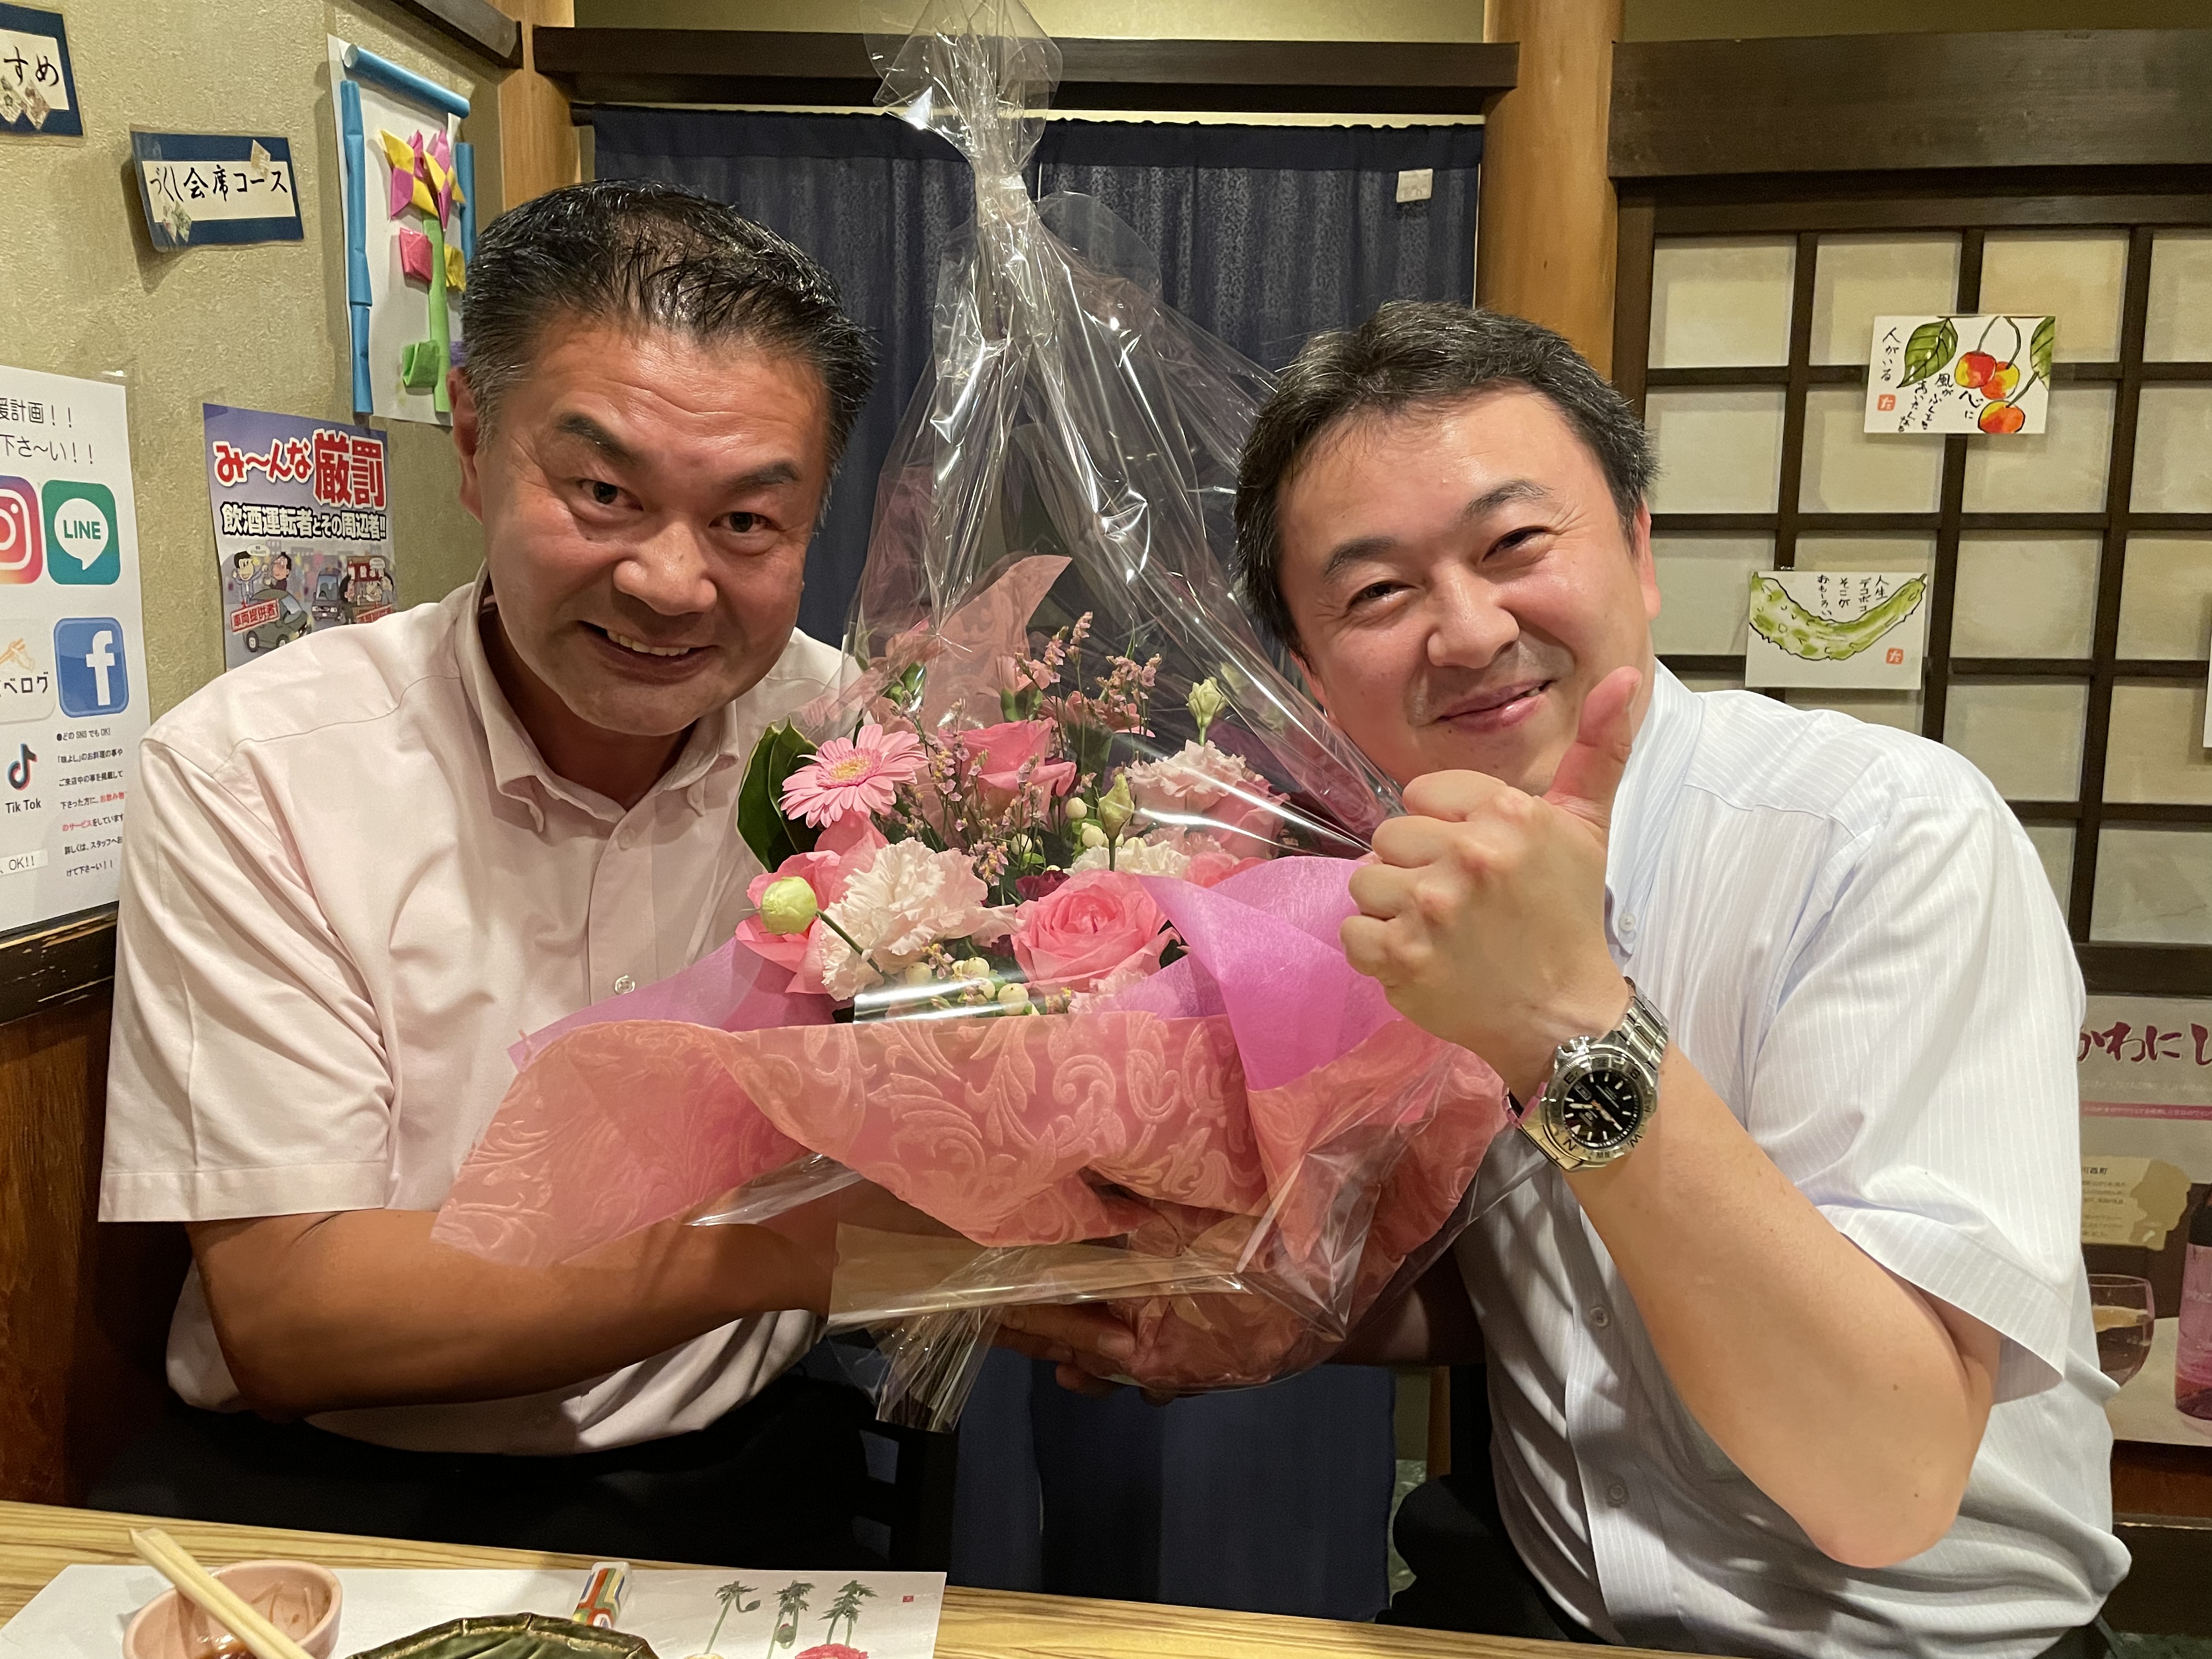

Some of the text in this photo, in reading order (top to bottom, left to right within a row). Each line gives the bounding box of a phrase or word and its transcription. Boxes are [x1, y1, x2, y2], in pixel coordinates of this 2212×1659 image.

[3, 46, 59, 87] すめ
[149, 165, 287, 202] づくし会席コース
[63, 520, 101, 540] LINE
[1875, 574, 1889, 601] 人生
[0, 671, 48, 693] べログ
